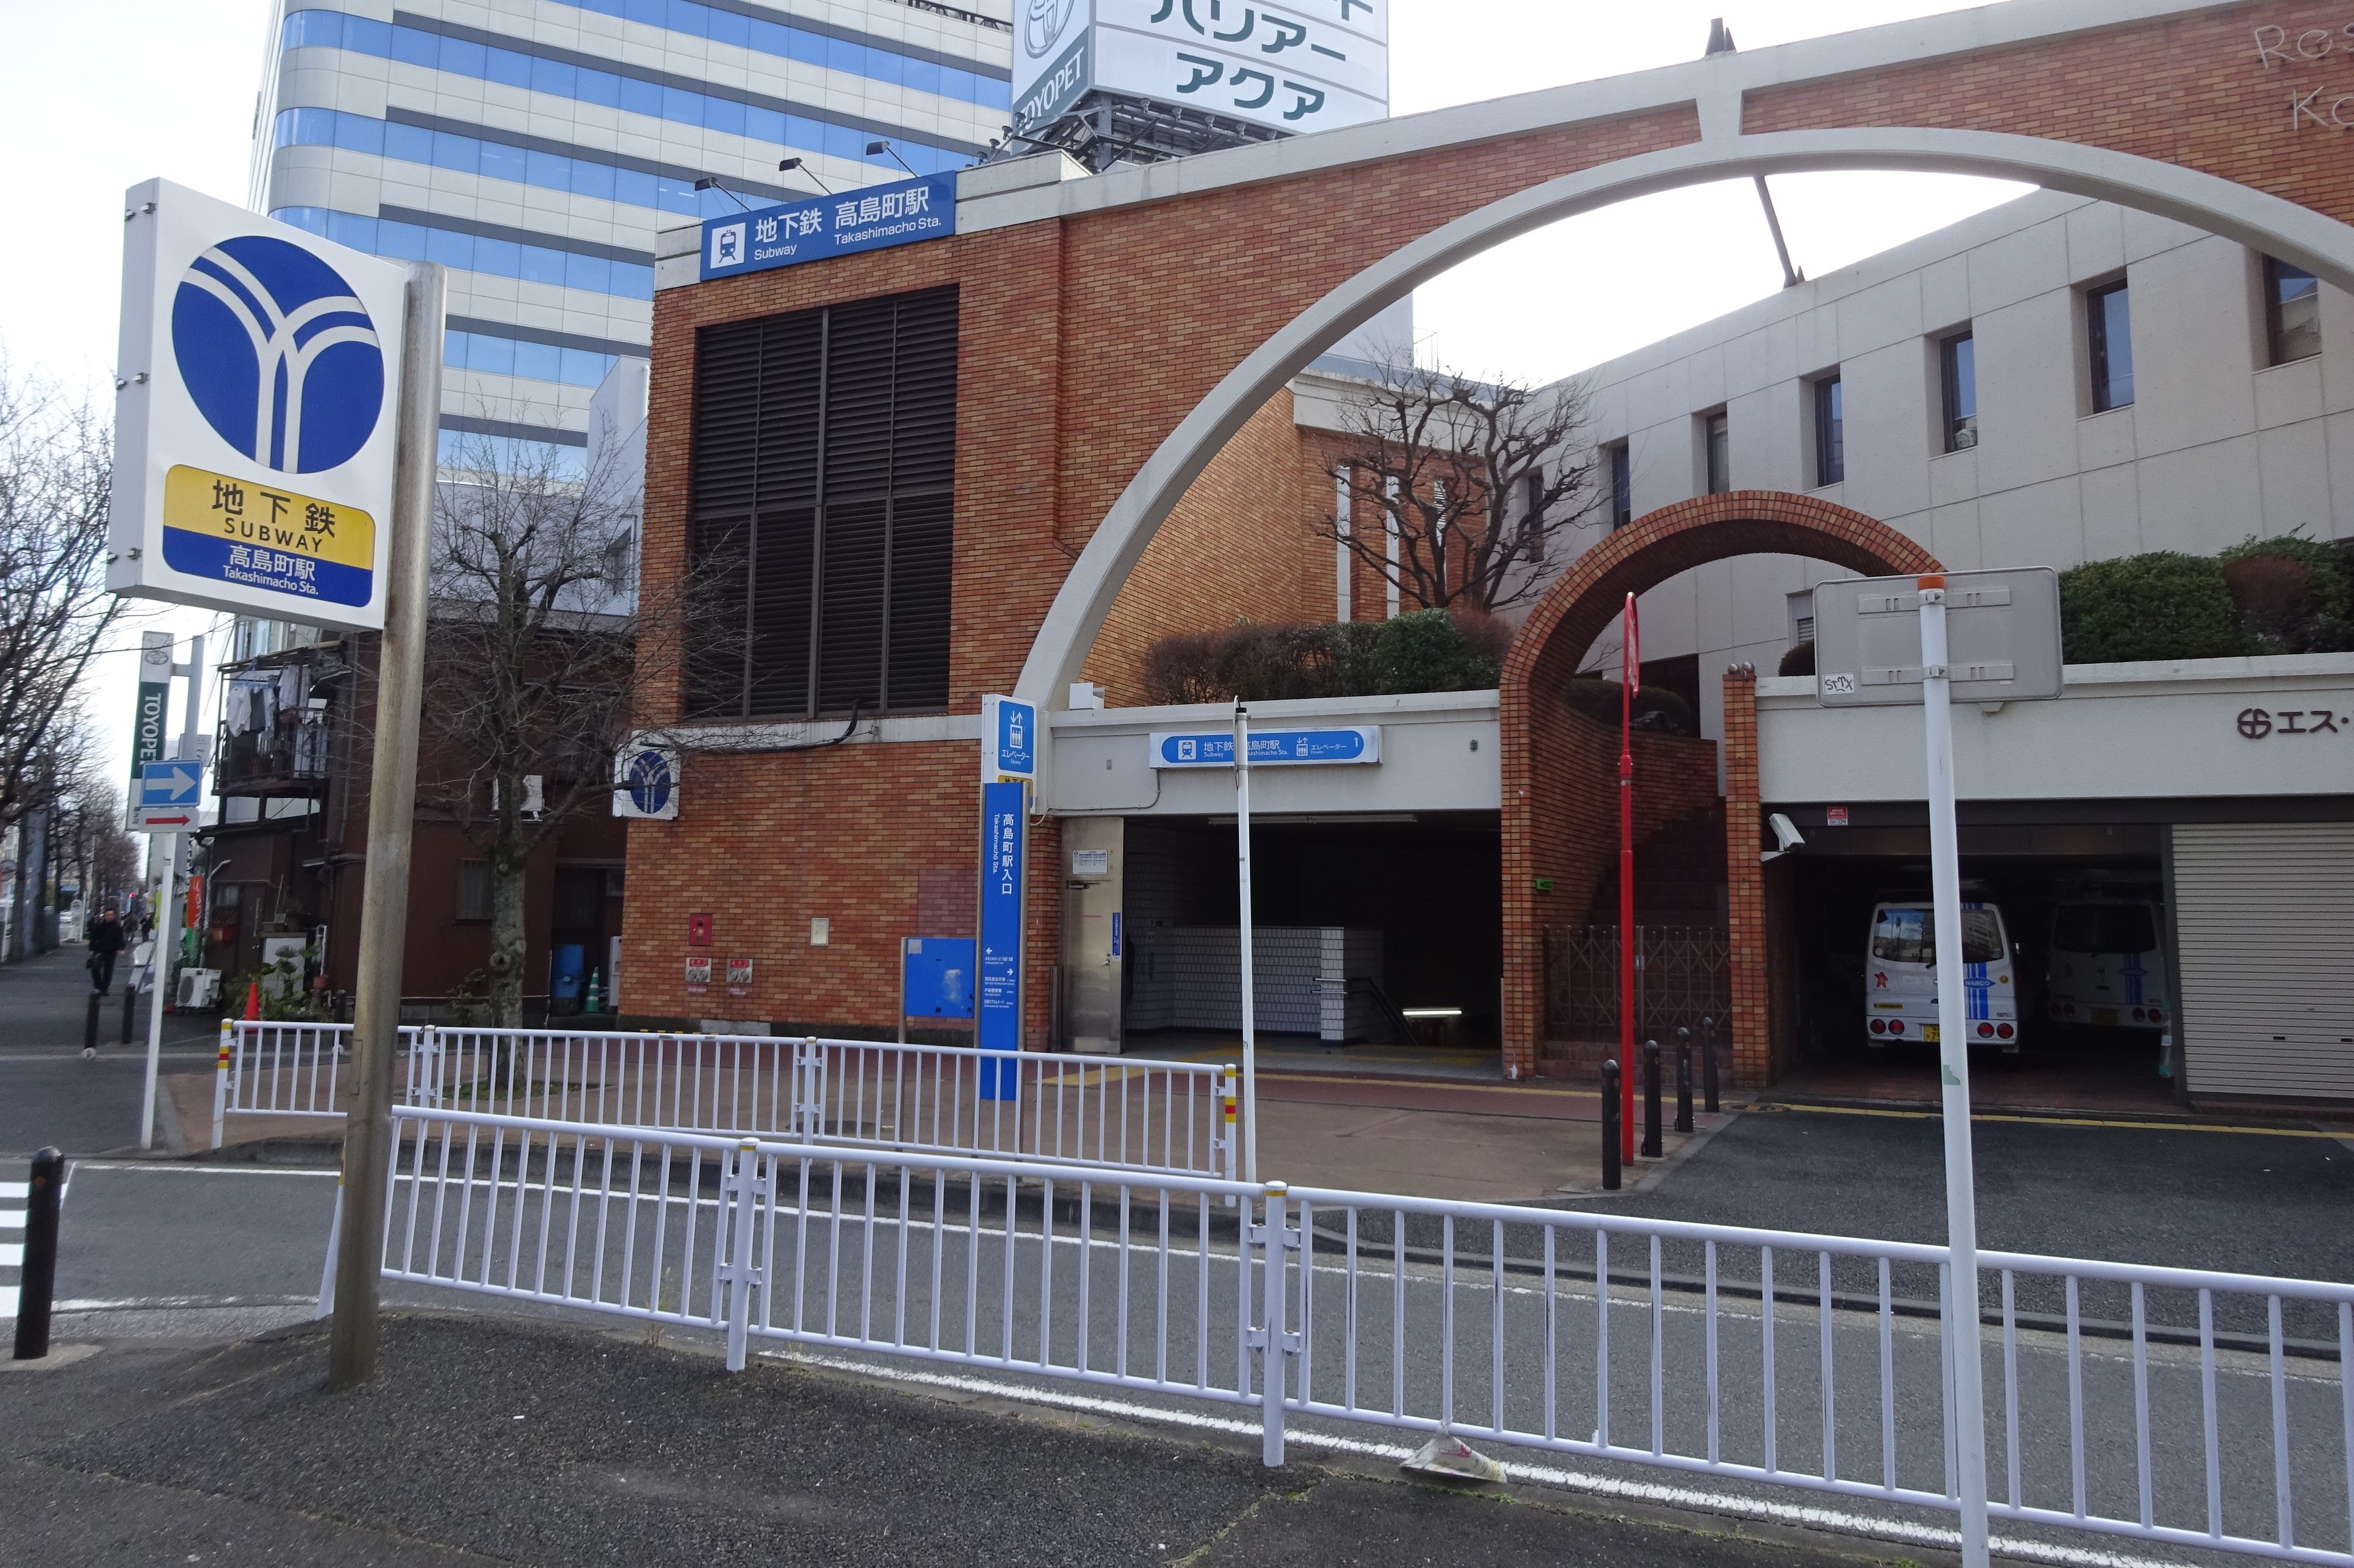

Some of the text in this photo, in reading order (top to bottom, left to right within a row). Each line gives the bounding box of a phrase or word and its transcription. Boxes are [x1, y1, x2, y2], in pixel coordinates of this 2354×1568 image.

[1176, 52, 1325, 121] アクア
[754, 186, 930, 244] 地下鉄 高島町駅
[754, 216, 941, 261] Subway Takashimacho Sta.
[211, 479, 336, 539] 地下鉄
[224, 517, 323, 554] SUBWAY
[222, 565, 319, 596] Takashimacho Sta.
[229, 545, 316, 581] 高島町駅
[1001, 749, 1031, 761] エレベーター
[1203, 741, 1233, 752] 地下鉄
[1354, 737, 1358, 747] 1
[1001, 813, 1014, 895] 高島町駅入口
